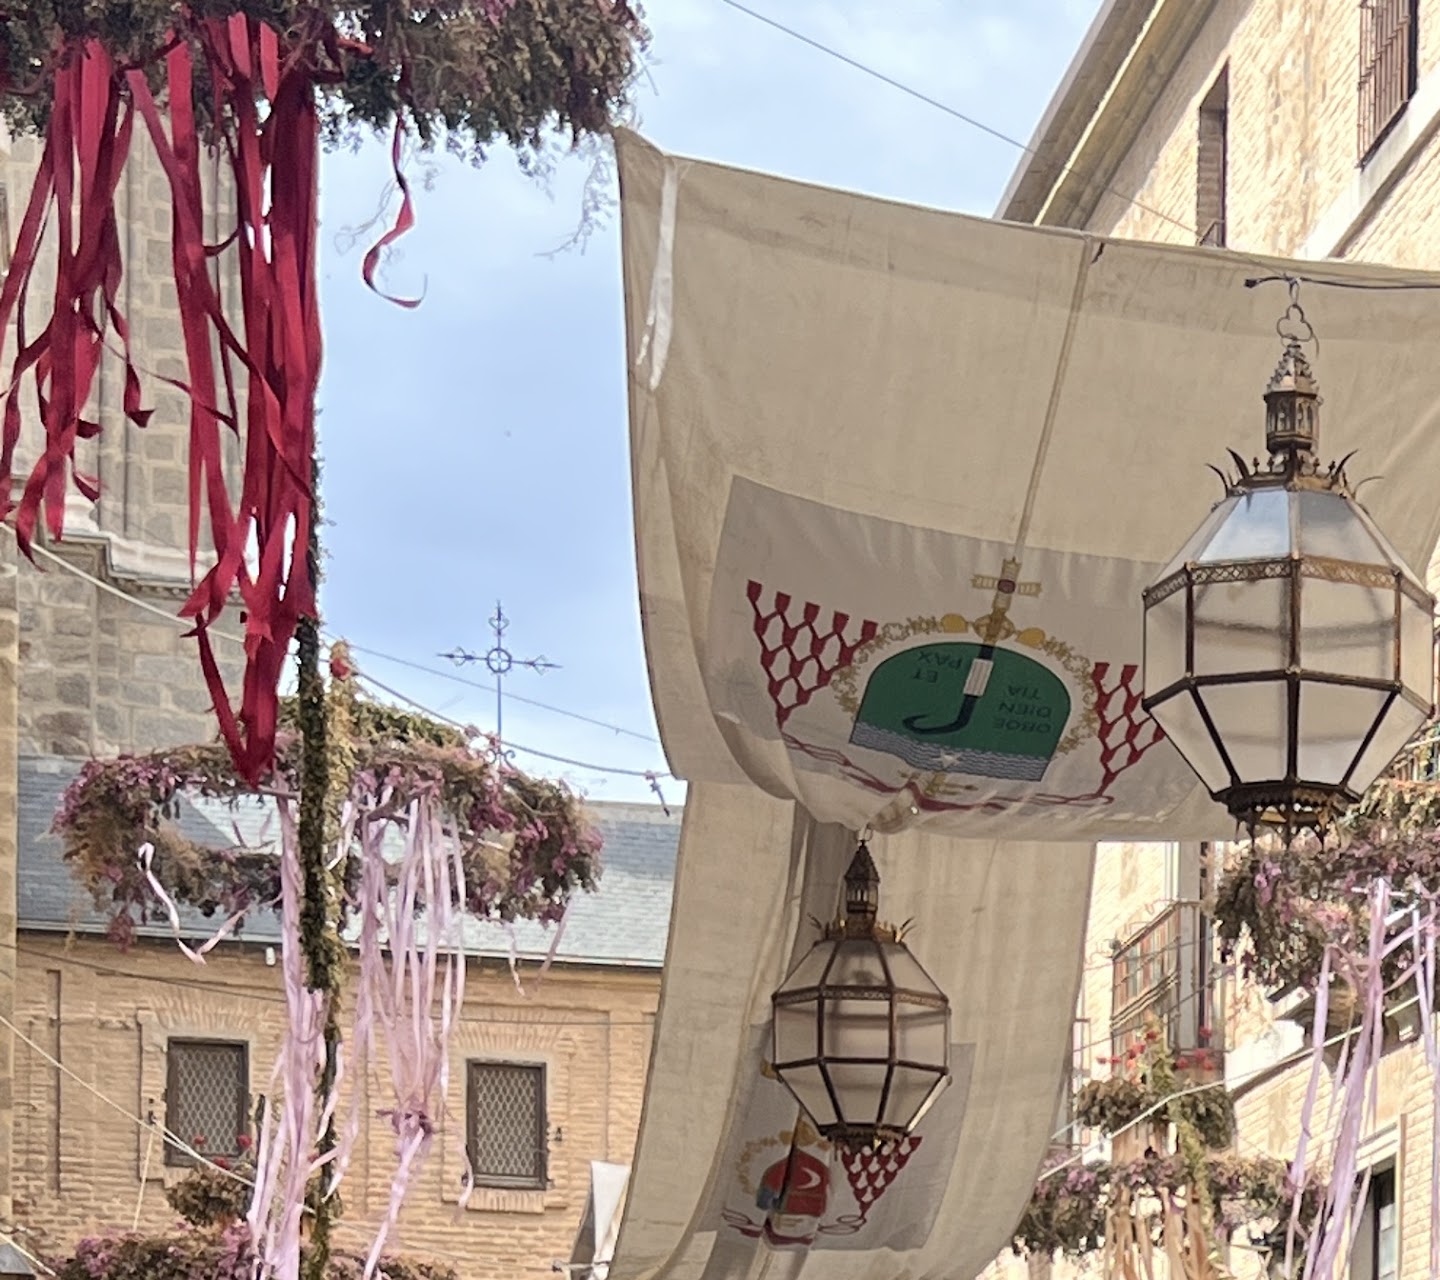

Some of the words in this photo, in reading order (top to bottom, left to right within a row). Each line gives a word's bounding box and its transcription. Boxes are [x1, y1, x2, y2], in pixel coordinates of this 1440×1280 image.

[917, 651, 962, 669] PAX
[912, 669, 938, 683] ET
[1009, 686, 1041, 700] TIA
[998, 700, 1052, 717] DIEN
[993, 718, 1052, 733] OBOE
